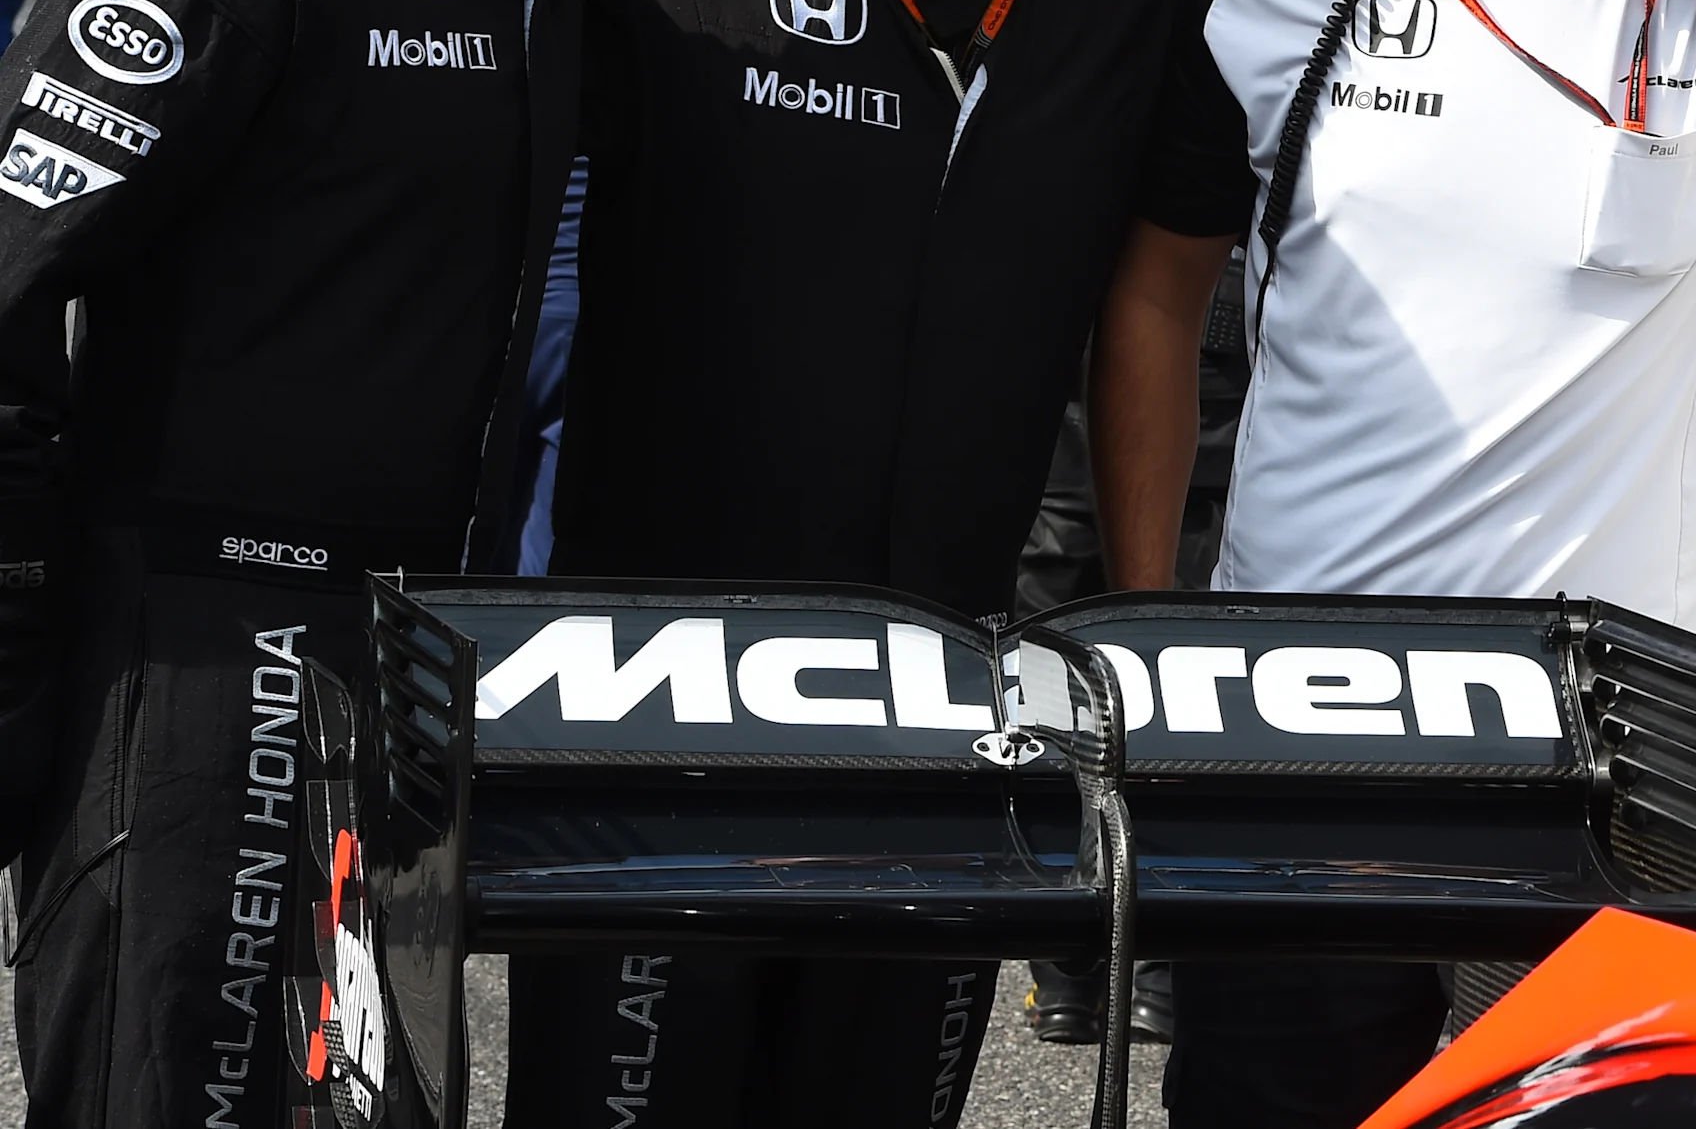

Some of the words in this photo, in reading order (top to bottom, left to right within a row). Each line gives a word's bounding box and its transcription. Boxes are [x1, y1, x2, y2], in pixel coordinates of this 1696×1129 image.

[88, 6, 167, 65] ESSO
[368, 29, 464, 68] Mobil
[20, 71, 162, 157] PIRELLI
[743, 67, 853, 121] Mobil
[1332, 82, 1409, 112] Mobil
[1, 142, 88, 200] SAP
[1648, 143, 1679, 158] Paul
[221, 536, 328, 568] sparco
[244, 625, 306, 828] HONDA
[206, 849, 288, 1128] McLAREN
[606, 955, 673, 1129] McLAR
[931, 972, 975, 1129] HOND
